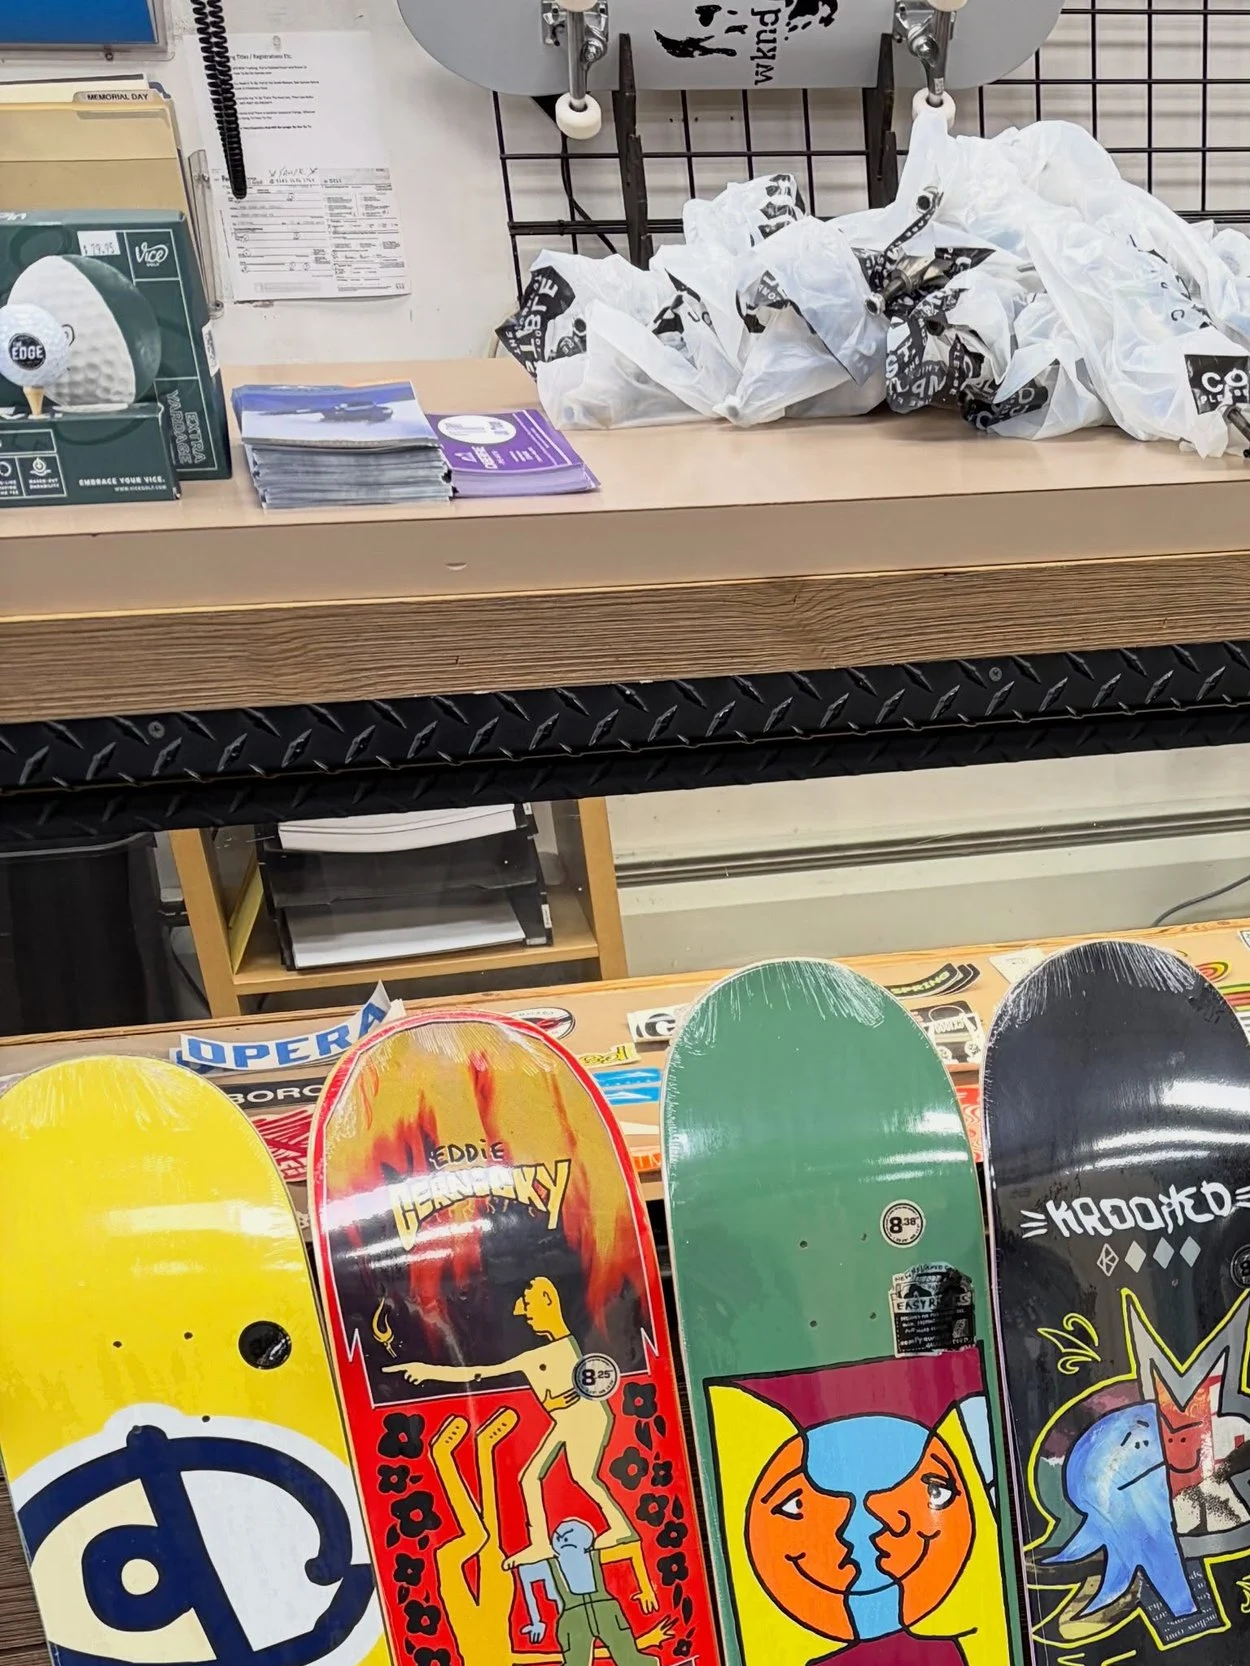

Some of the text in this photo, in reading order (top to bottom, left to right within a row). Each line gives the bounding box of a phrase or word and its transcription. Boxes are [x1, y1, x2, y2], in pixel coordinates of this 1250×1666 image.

[750, 7, 781, 86] wknd
[87, 93, 149, 101] MEMORIAL DAY
[11, 345, 44, 360] EDGE
[166, 389, 193, 465] YARDAGE
[184, 411, 207, 465] EXTRA
[79, 477, 118, 487] EMBRACE
[119, 476, 142, 485] YOUR
[897, 1299, 926, 1311] EASY
